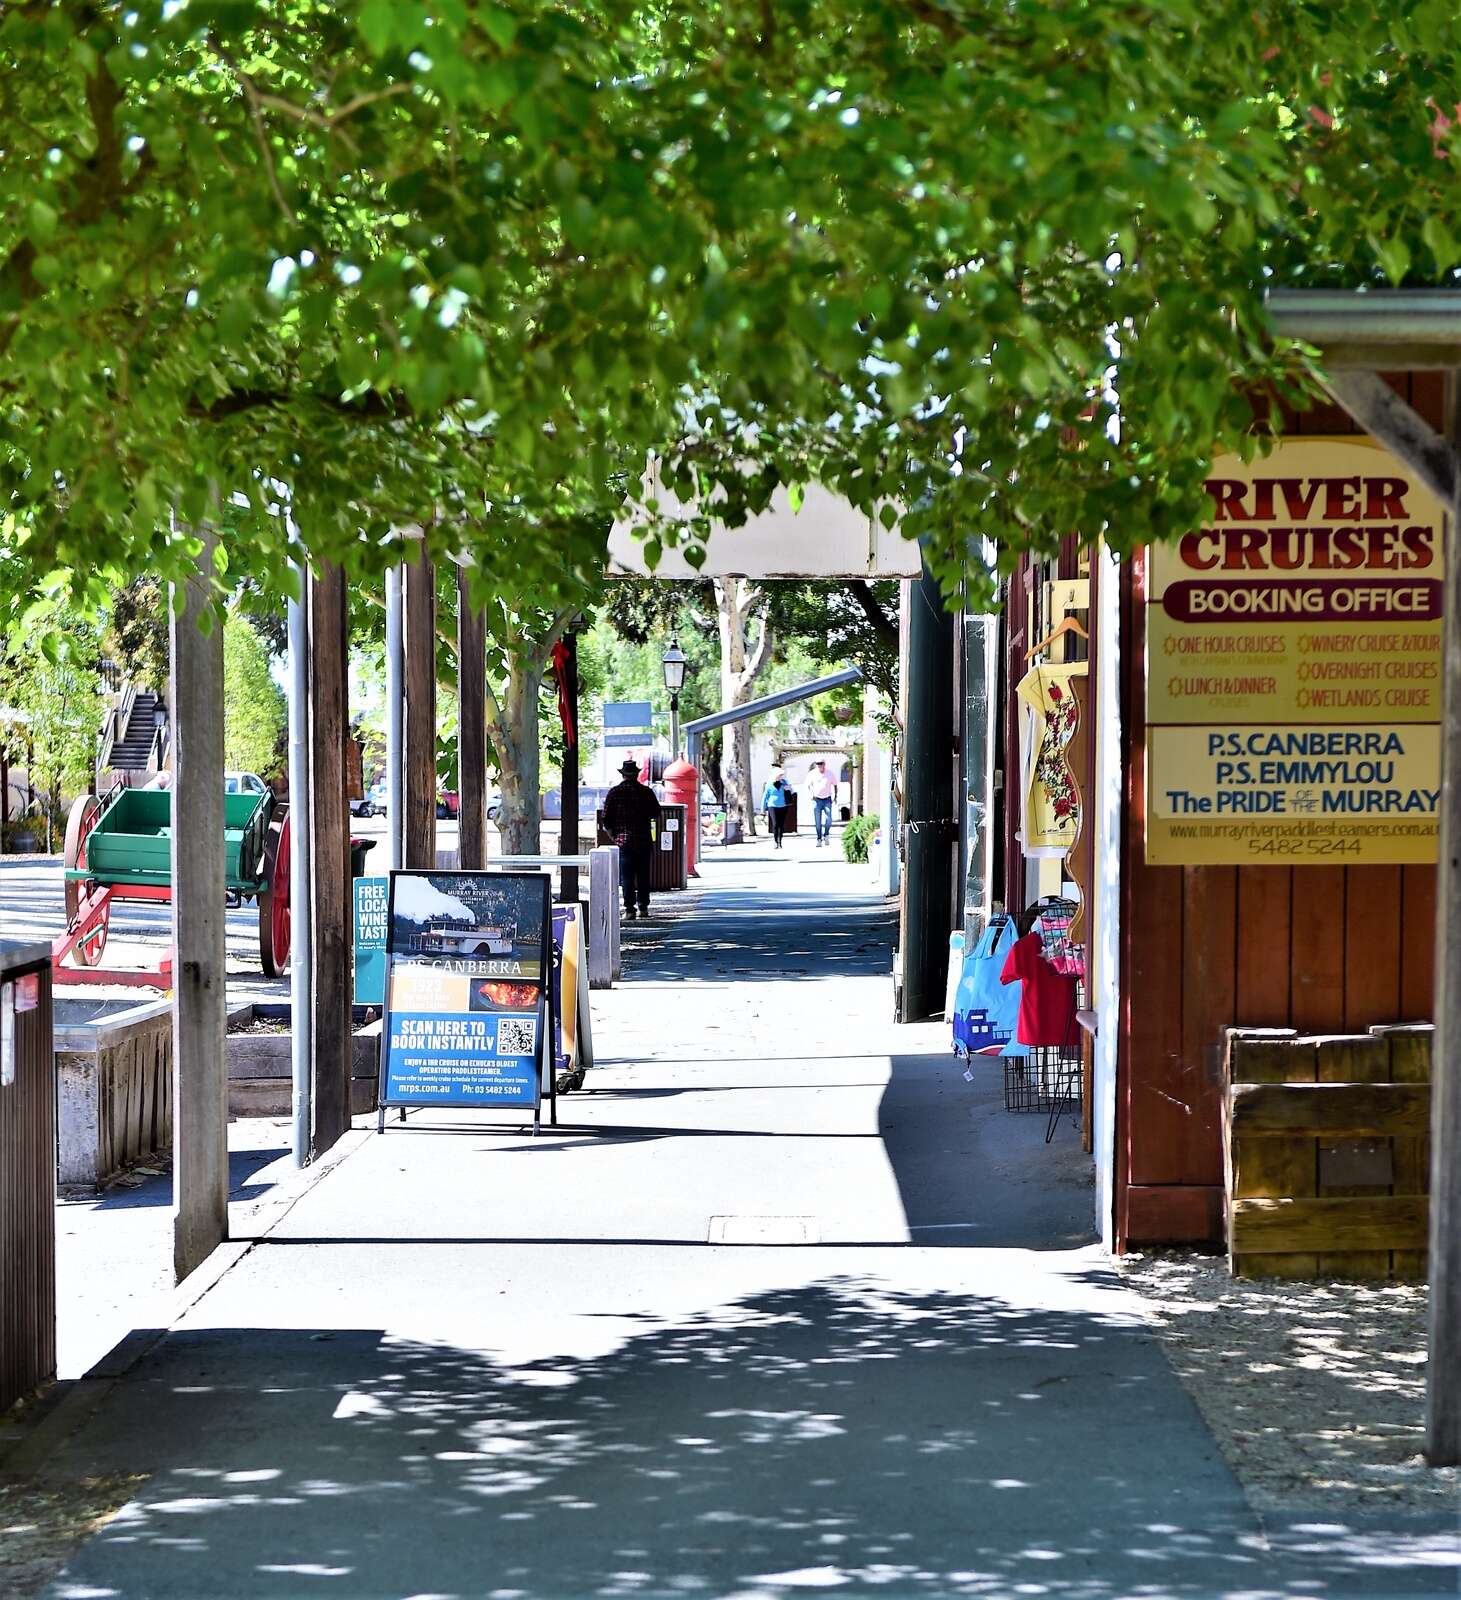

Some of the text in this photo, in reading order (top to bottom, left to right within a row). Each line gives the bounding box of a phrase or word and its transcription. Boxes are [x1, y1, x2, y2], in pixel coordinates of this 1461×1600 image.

[1203, 476, 1410, 521] RIVER
[1180, 525, 1433, 570] CRUISES
[1189, 588, 1430, 613] BOOKING OFFICE
[1177, 634, 1286, 654] ONE HOUR CRUISES
[1311, 634, 1356, 652] WINERY
[1358, 634, 1400, 652] CRUISE
[1311, 662, 1438, 680] OVERNIGHT CRUISES
[1311, 688, 1430, 707] WETLANDS CRUISE
[1166, 791, 1212, 813] The
[1216, 791, 1286, 812] PRIDE
[1322, 790, 1440, 812] MURRAY
[1249, 838, 1362, 855] 5482 5244
[358, 885, 385, 899] FREE
[358, 899, 388, 912] LOCA
[358, 912, 388, 926] WINE
[358, 926, 388, 940] TAST
[431, 960, 522, 974] CANBERRA
[401, 1020, 486, 1036] SCAN HERE TO
[391, 1034, 495, 1051] BOOK INSTANTLY
[419, 1066, 452, 1074] OPERATING
[398, 1084, 521, 1094] mrps.com.au Ph: 03 5482 5244
